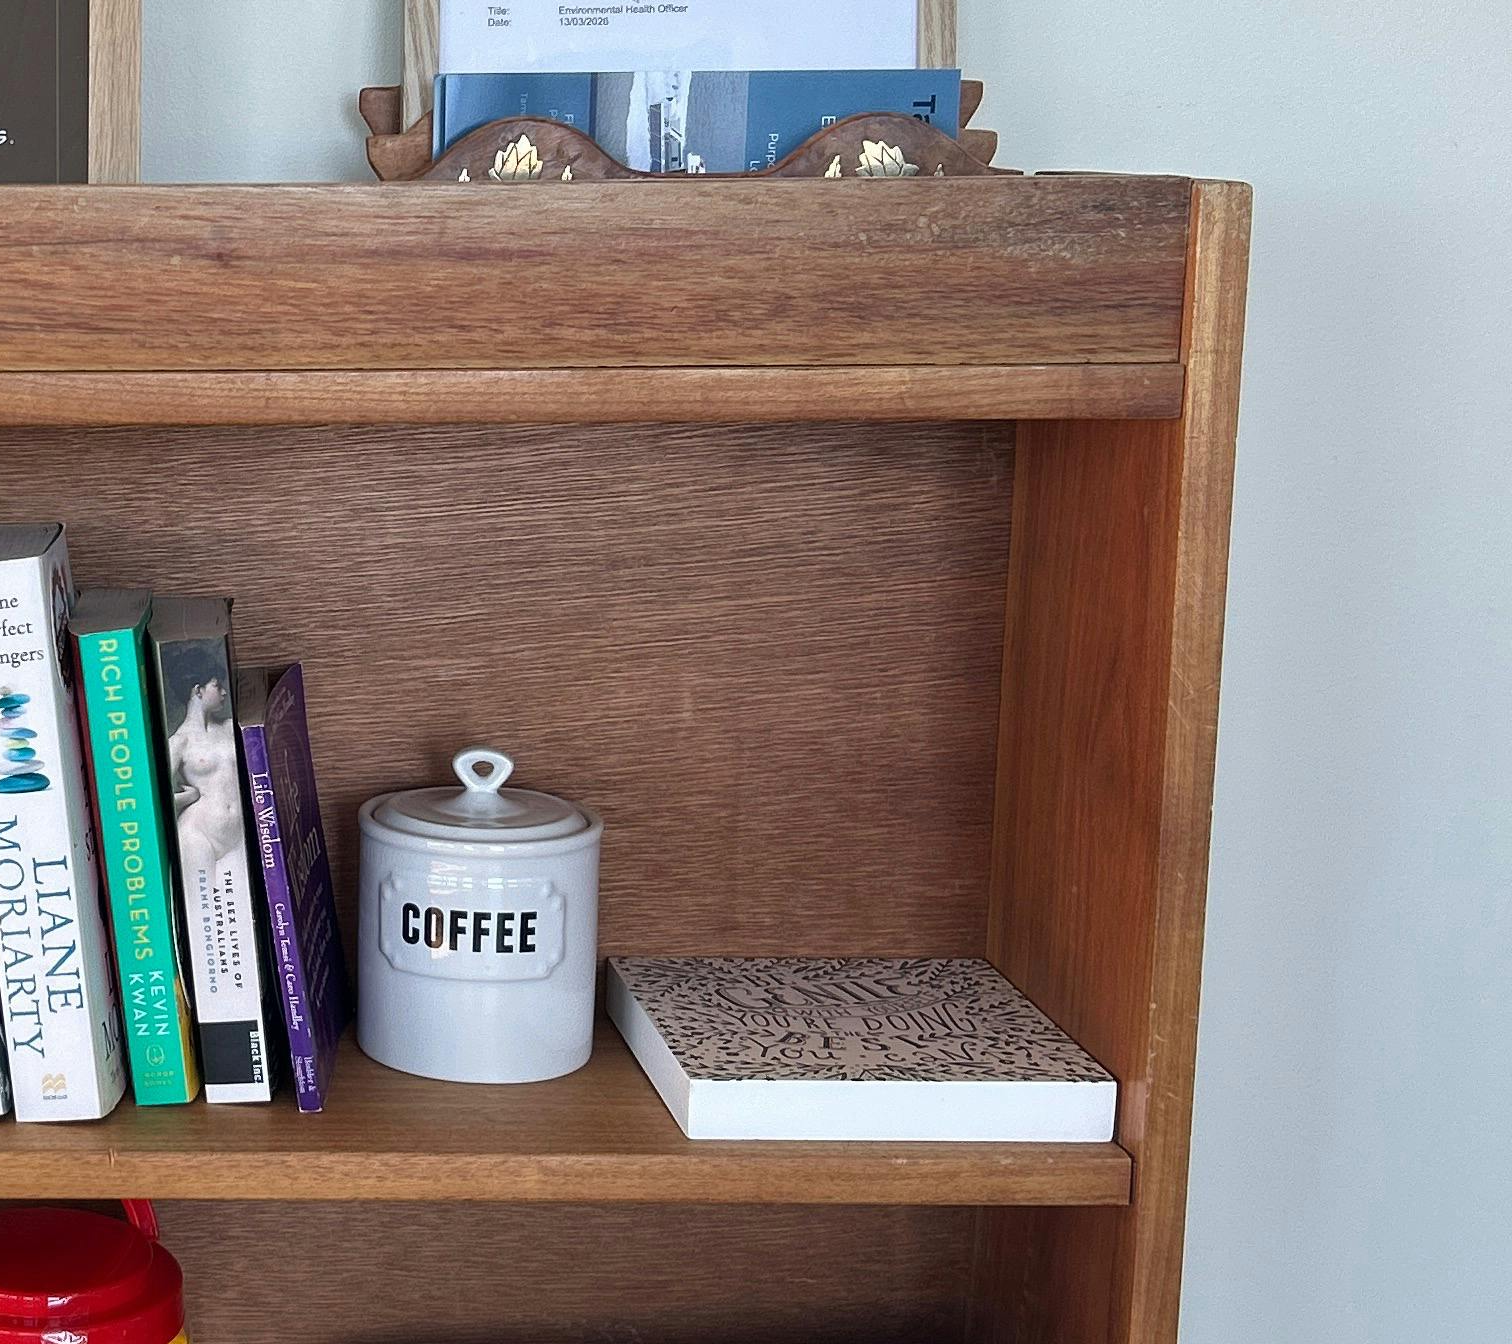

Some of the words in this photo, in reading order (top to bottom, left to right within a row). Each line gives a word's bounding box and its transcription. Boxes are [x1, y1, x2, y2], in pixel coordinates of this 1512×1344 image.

[98, 639, 123, 702] RICH
[108, 711, 137, 812] PEOPLE
[120, 821, 153, 961] PROBLEMS
[32, 855, 83, 1014] LIANE
[401, 901, 539, 955] COFFEE
[129, 973, 150, 1036] KWAN
[148, 970, 170, 1036] KEVIN
